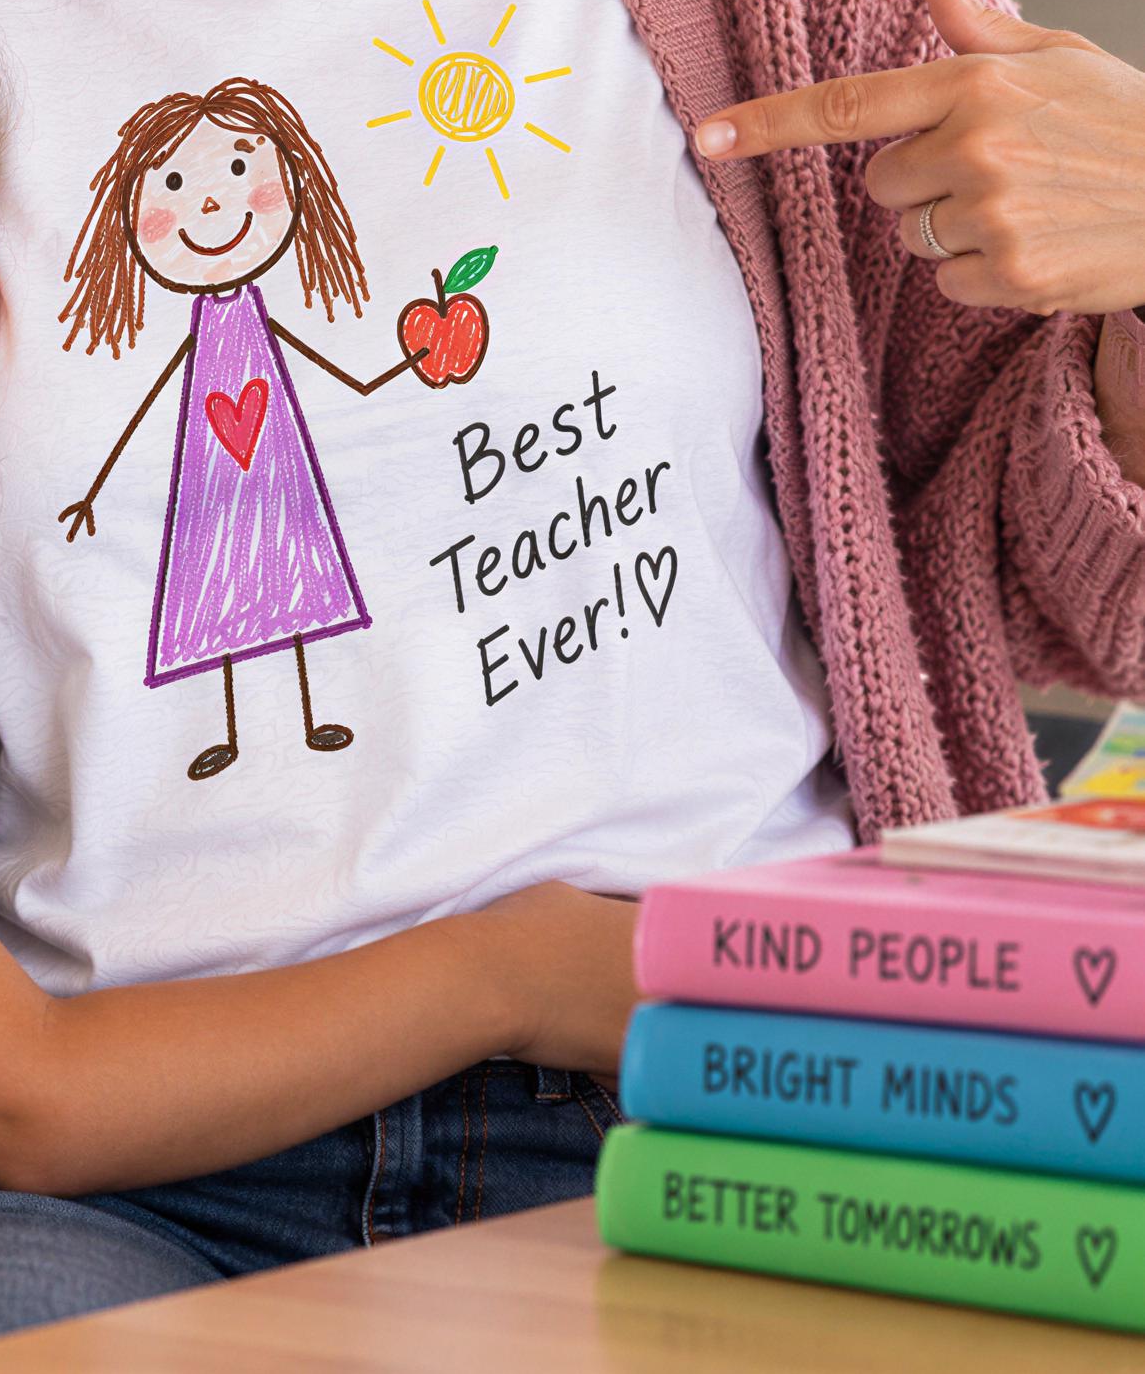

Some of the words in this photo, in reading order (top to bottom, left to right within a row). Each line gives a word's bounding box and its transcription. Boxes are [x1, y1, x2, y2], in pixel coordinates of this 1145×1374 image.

[454, 370, 616, 505] Best
[428, 462, 670, 614] Teacher
[711, 919, 822, 974] KIND
[848, 928, 1022, 993] PEOPLE
[702, 1042, 861, 1108] BRIGHT
[880, 1062, 1019, 1126] MINDS
[662, 1171, 800, 1236] BETTER
[817, 1194, 1041, 1271] TOMORROWS
